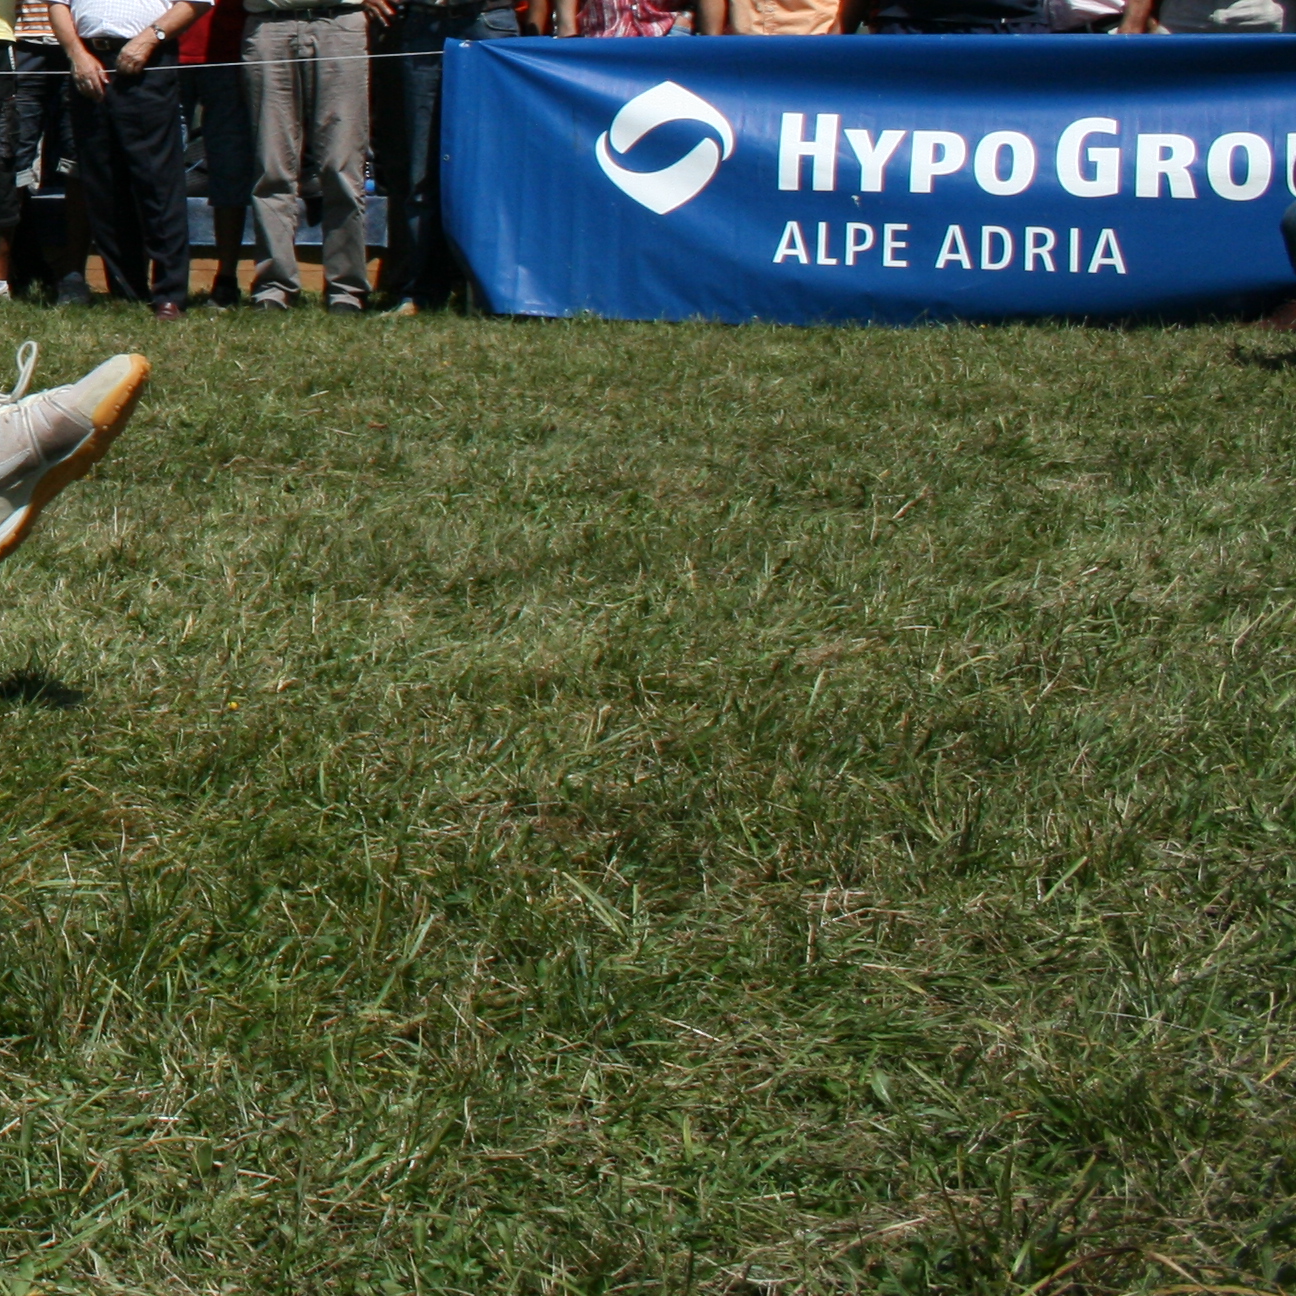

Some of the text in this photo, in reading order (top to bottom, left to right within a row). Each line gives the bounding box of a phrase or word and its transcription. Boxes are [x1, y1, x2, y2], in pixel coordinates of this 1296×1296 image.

[1056, 117, 1296, 202] GRO
[773, 220, 1127, 275] ALPE ADRIA
